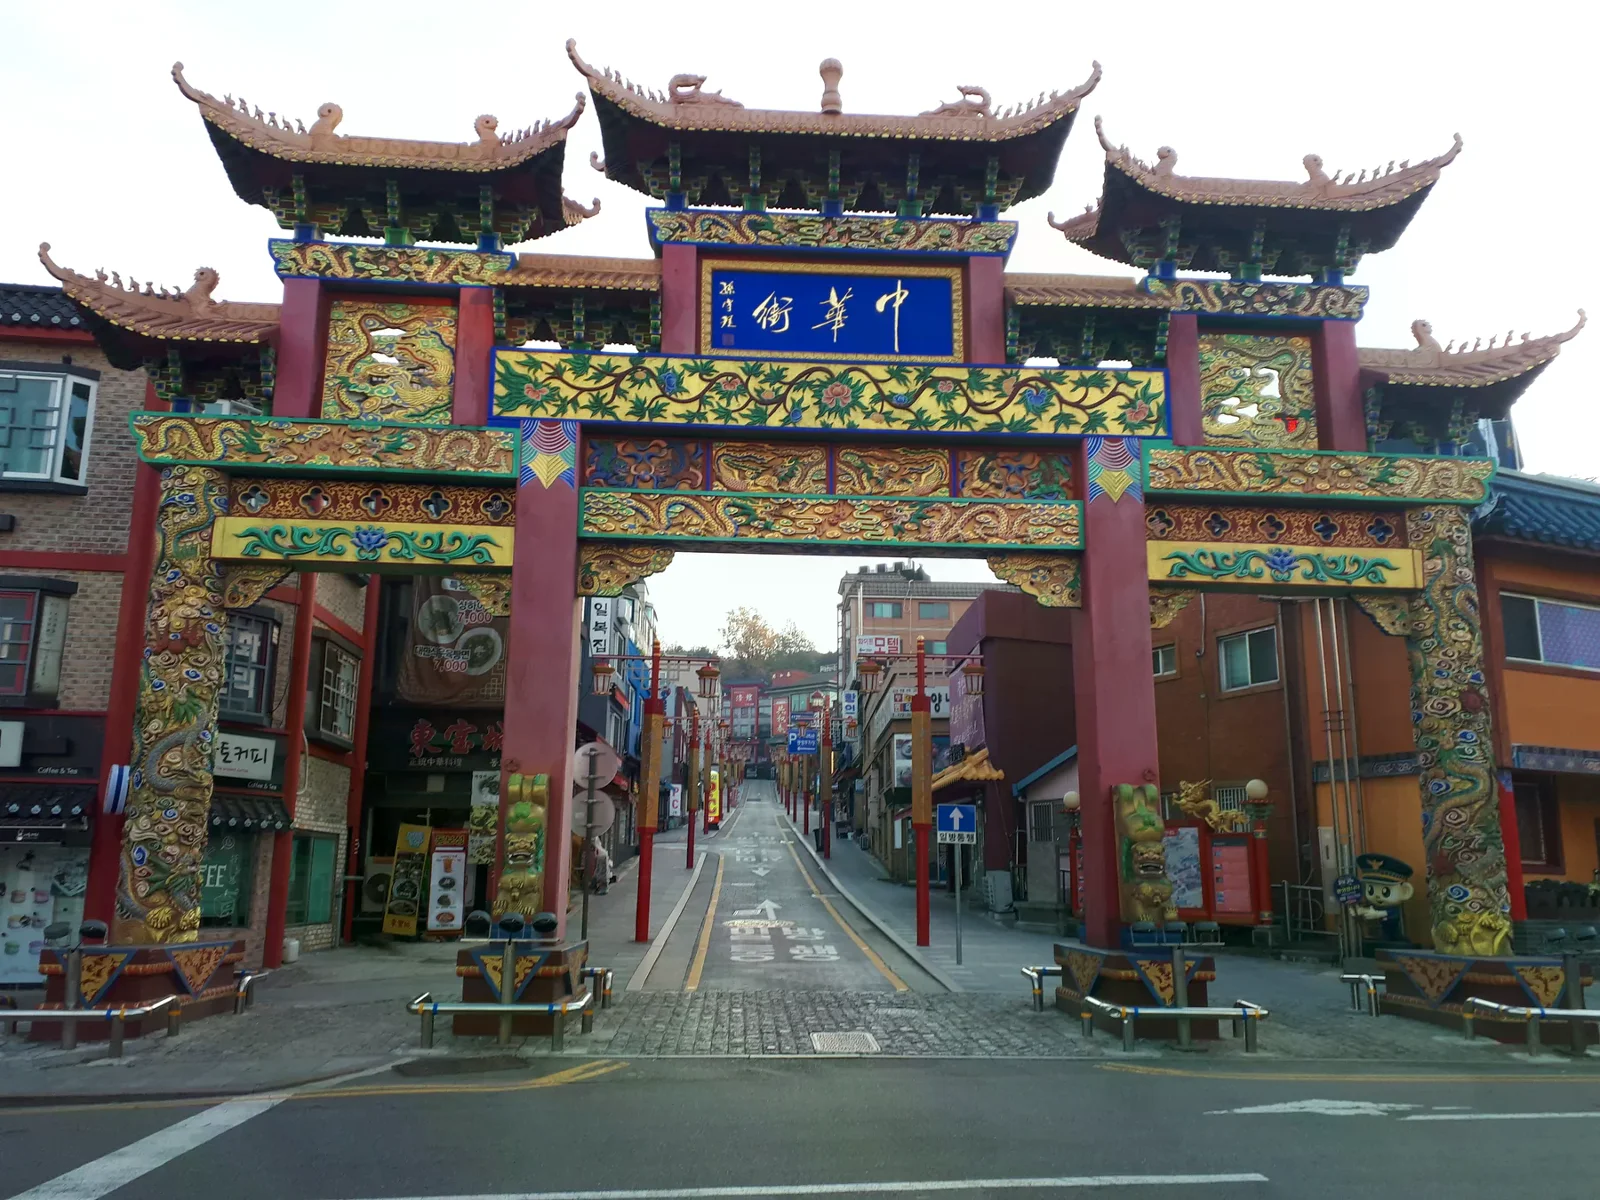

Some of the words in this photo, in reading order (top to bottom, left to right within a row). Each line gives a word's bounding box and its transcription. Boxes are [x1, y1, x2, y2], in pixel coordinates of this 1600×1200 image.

[457, 611, 493, 624] 7,000
[874, 638, 899, 655] 모텔
[433, 659, 469, 672] 7,000
[789, 733, 797, 746] P
[37, 766, 59, 774] Coffee
[939, 832, 975, 843] 일방통행
